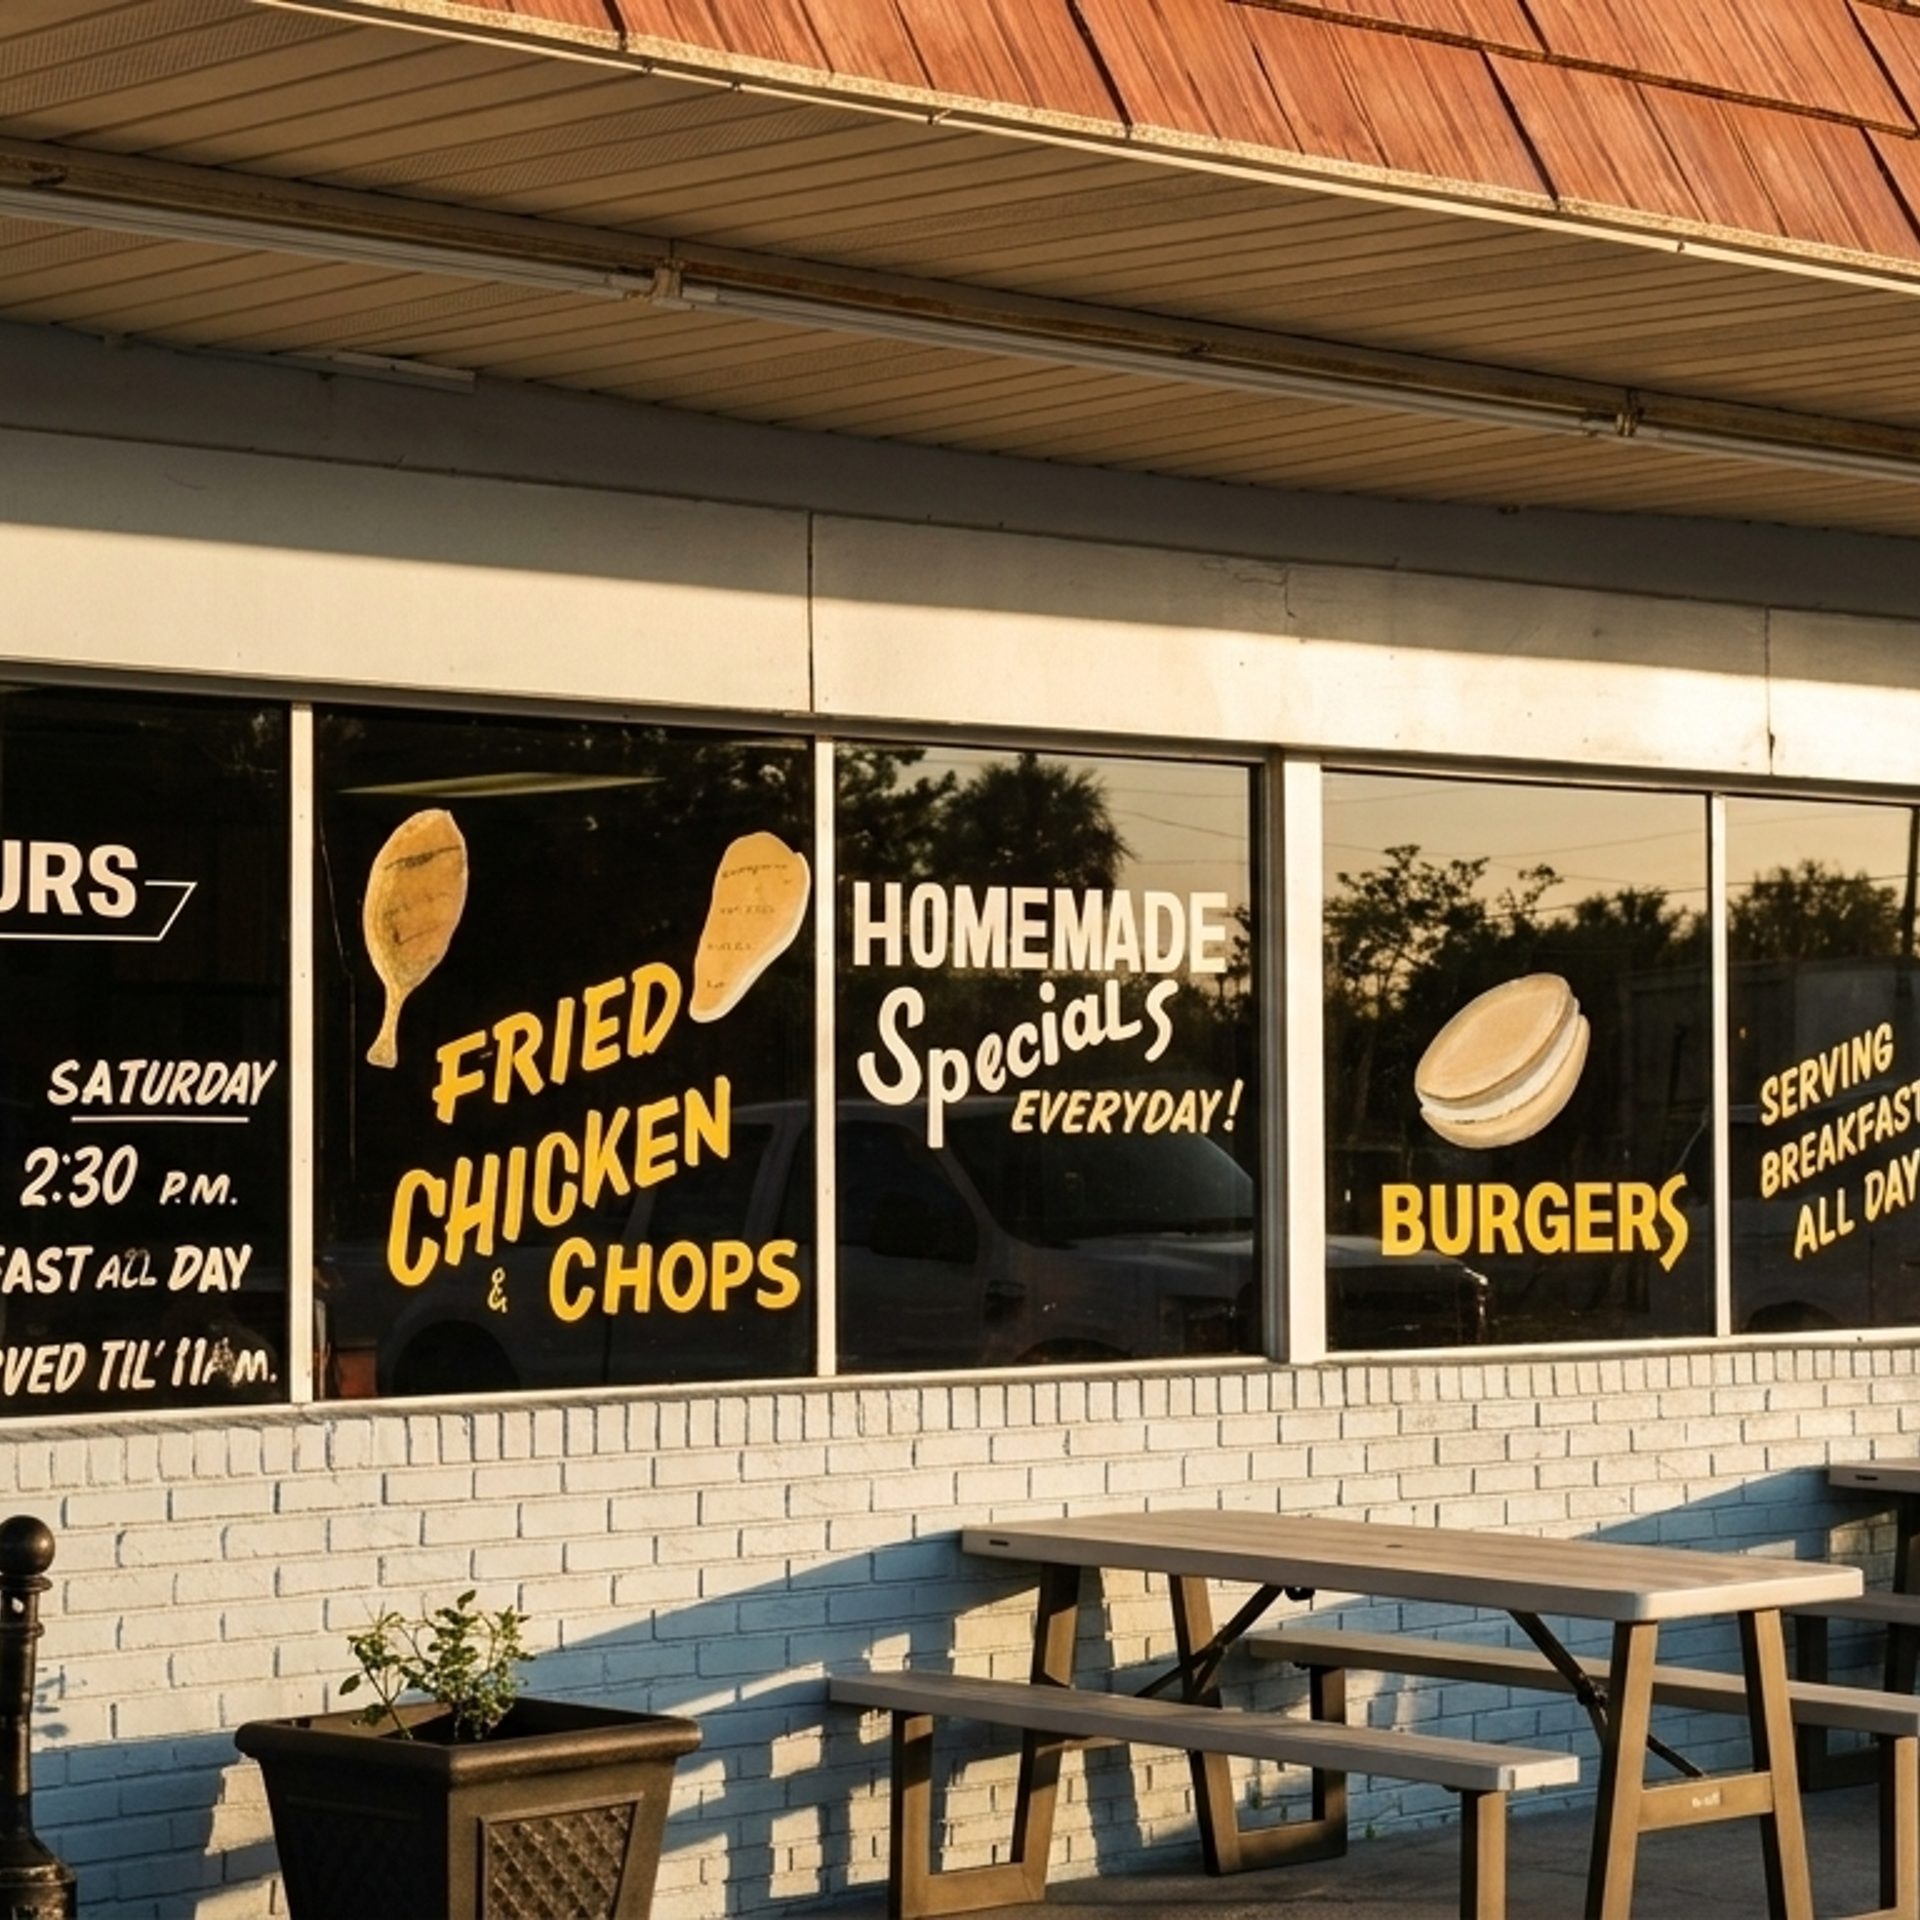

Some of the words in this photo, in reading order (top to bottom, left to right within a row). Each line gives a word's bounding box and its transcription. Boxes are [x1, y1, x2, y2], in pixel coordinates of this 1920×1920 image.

[853, 880, 1229, 975] HOMEMADE
[47, 1059, 278, 1106] SATURDAY
[431, 961, 683, 1124] FRIED
[1760, 1021, 1894, 1127] SERVING
[1011, 1078, 1244, 1135] EVERYDAY!
[20, 1144, 138, 1208] 2:30
[159, 1170, 238, 1205] P.M.
[387, 1075, 732, 1288] CHICKEN
[1793, 1187, 1856, 1261] ALL
[1865, 1147, 1920, 1222] DAY
[1381, 1172, 1689, 1272] BURGERS
[0, 1245, 94, 1294] AST
[167, 1244, 253, 1293] DAY
[486, 1266, 508, 1314] &
[548, 1236, 801, 1323] CHOPS
[0, 1342, 87, 1396] VED
